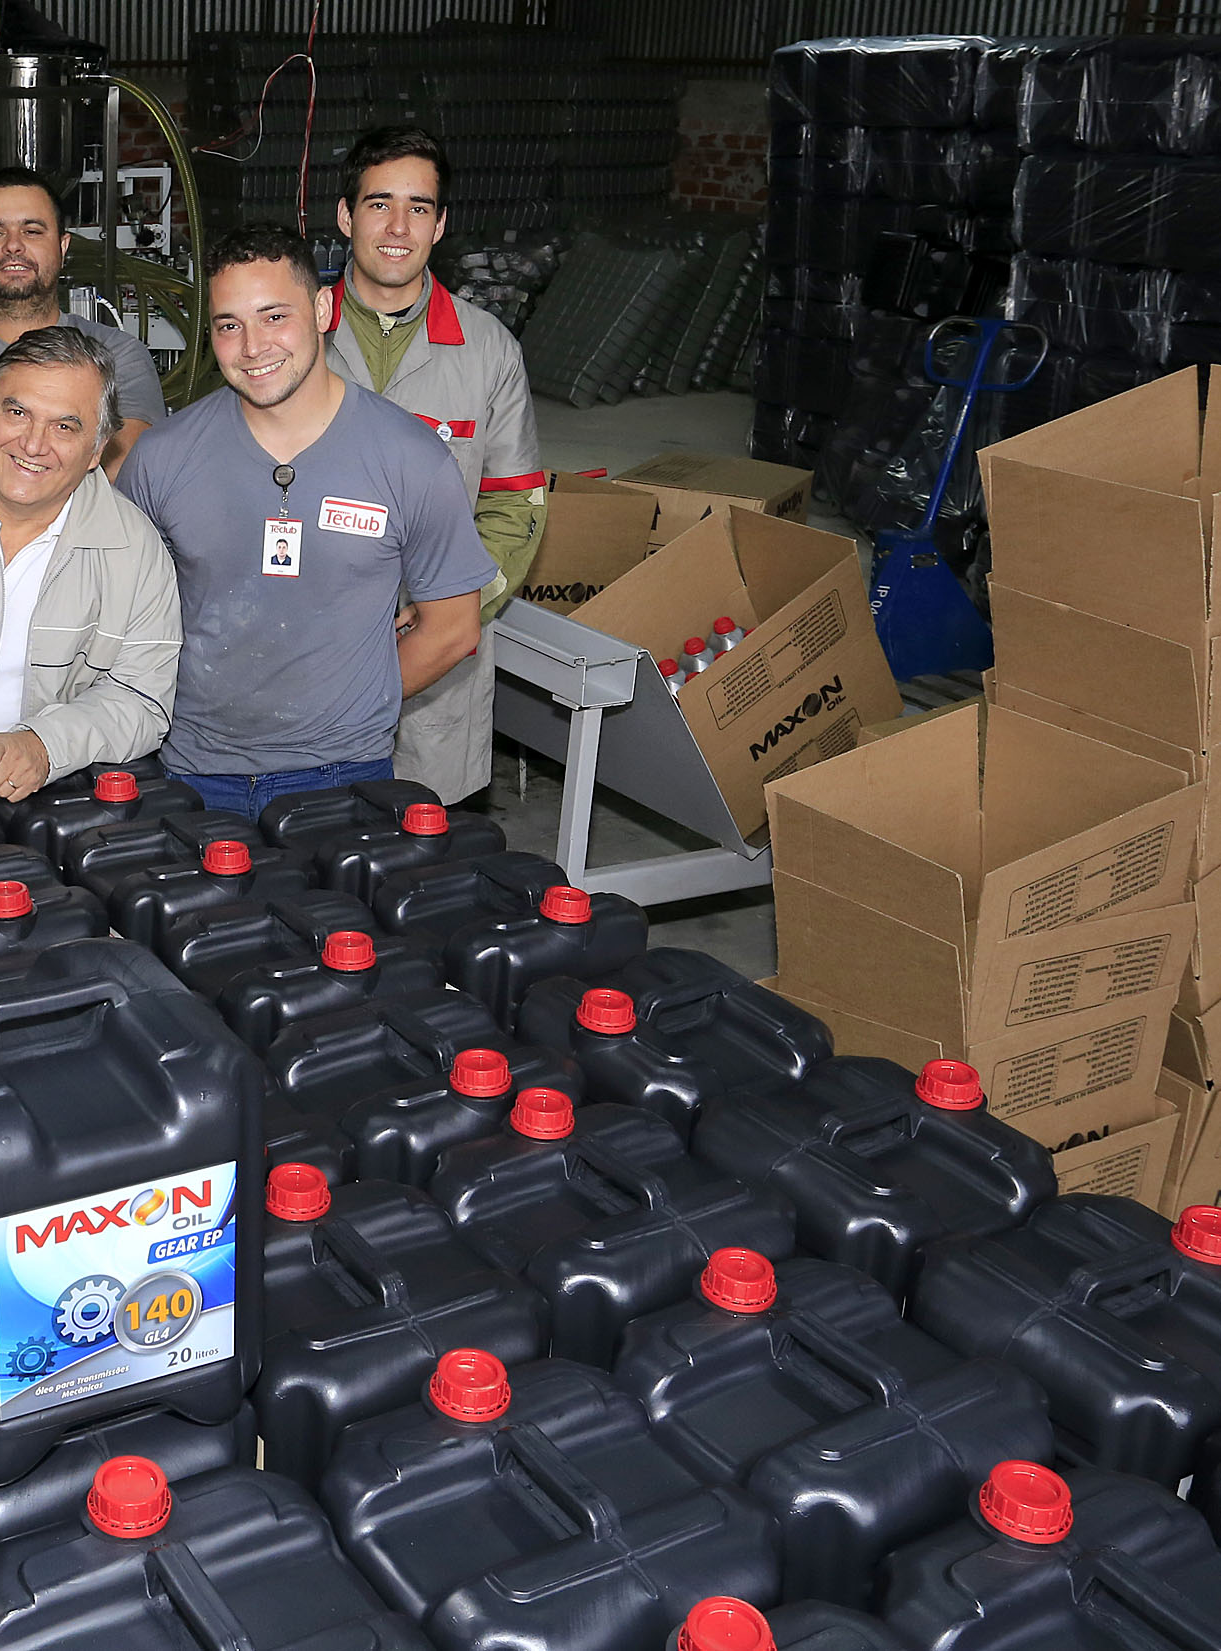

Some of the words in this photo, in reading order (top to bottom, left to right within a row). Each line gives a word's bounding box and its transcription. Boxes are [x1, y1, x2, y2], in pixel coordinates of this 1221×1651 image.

[270, 525, 297, 535] Teclub
[325, 509, 380, 532] Teclub
[522, 582, 605, 603] MAXON
[877, 585, 890, 598] IP
[826, 694, 847, 712] OIL
[749, 675, 843, 762] MAXON
[16, 1180, 212, 1254] MAXON
[172, 1213, 212, 1231] OIL
[155, 1236, 199, 1260] GEAR
[203, 1229, 223, 1247] EP
[125, 1288, 192, 1330] 140
[144, 1327, 170, 1345] GL4
[167, 1347, 192, 1368] 20
[195, 1347, 219, 1361] litros
[35, 1386, 54, 1397] Óleo
[55, 1380, 75, 1392] para
[77, 1365, 129, 1385] Transmissões
[61, 1382, 104, 1399] Mecânicas
